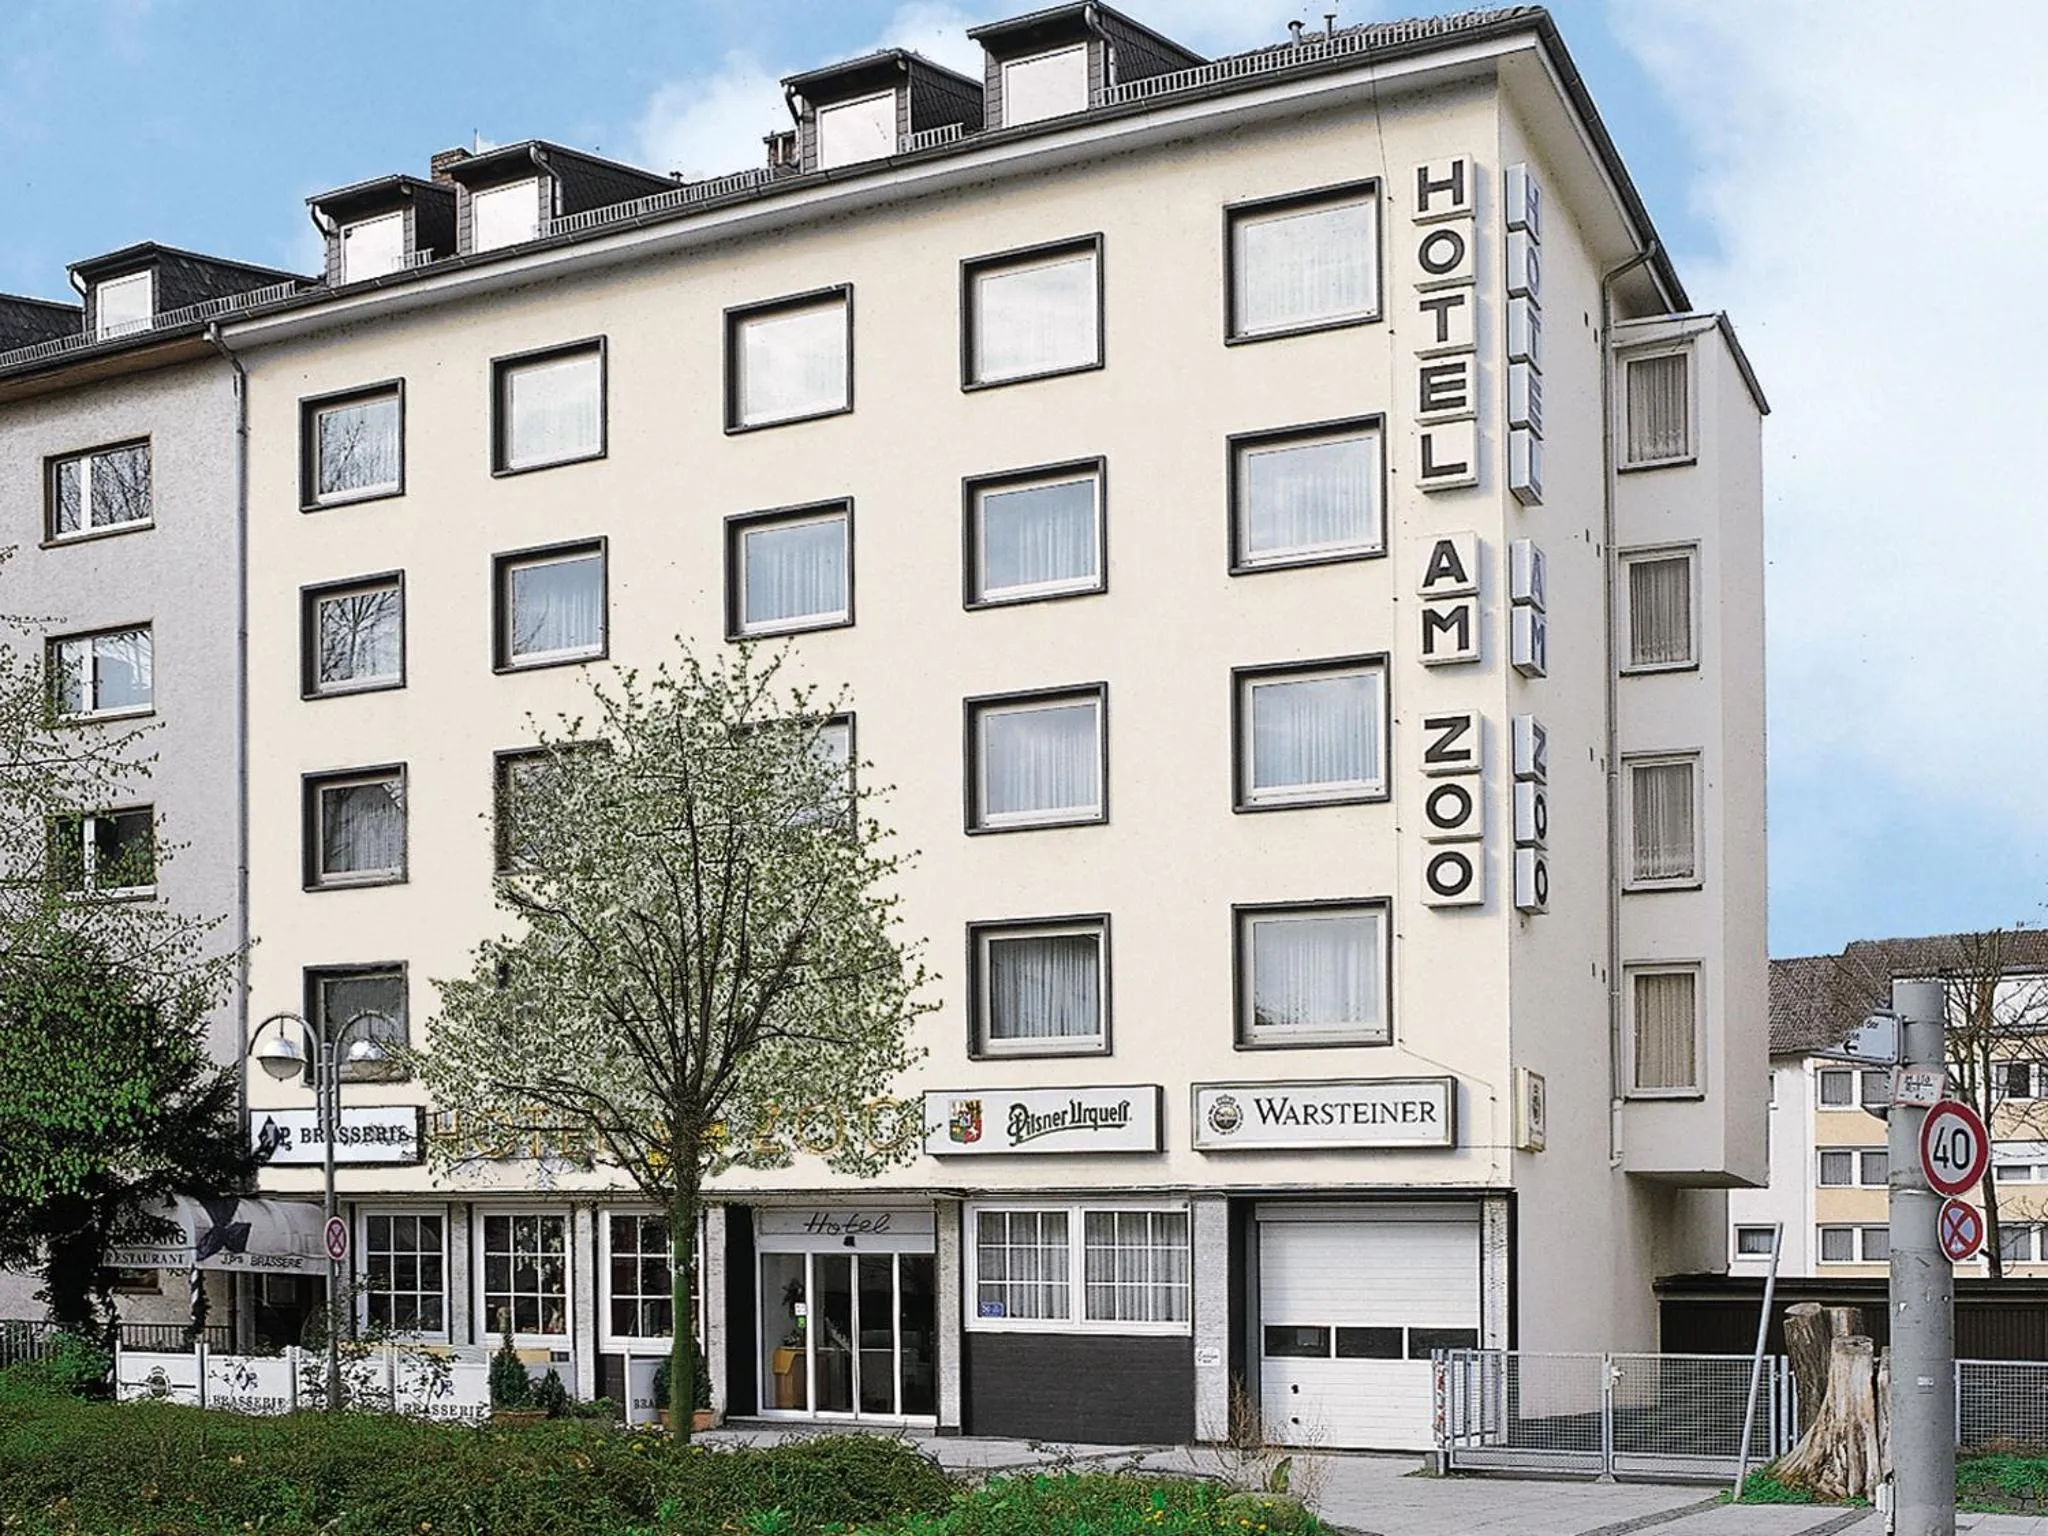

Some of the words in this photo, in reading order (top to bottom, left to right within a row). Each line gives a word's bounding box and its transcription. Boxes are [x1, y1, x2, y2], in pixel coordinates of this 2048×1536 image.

[1417, 159, 1468, 479] HOTEL
[1526, 175, 1542, 495] HOTEL
[1422, 539, 1470, 655] AM
[1423, 715, 1473, 896] ZOO
[1533, 722, 1548, 906] ZOO
[1007, 1103, 1068, 1146] Pilsner
[1069, 1099, 1131, 1131] Urquell
[1254, 1097, 1437, 1126] WARSTEINER
[1932, 1126, 1970, 1170] 40
[105, 1251, 185, 1264] RESTAURANT
[803, 1212, 891, 1235] Hotel
